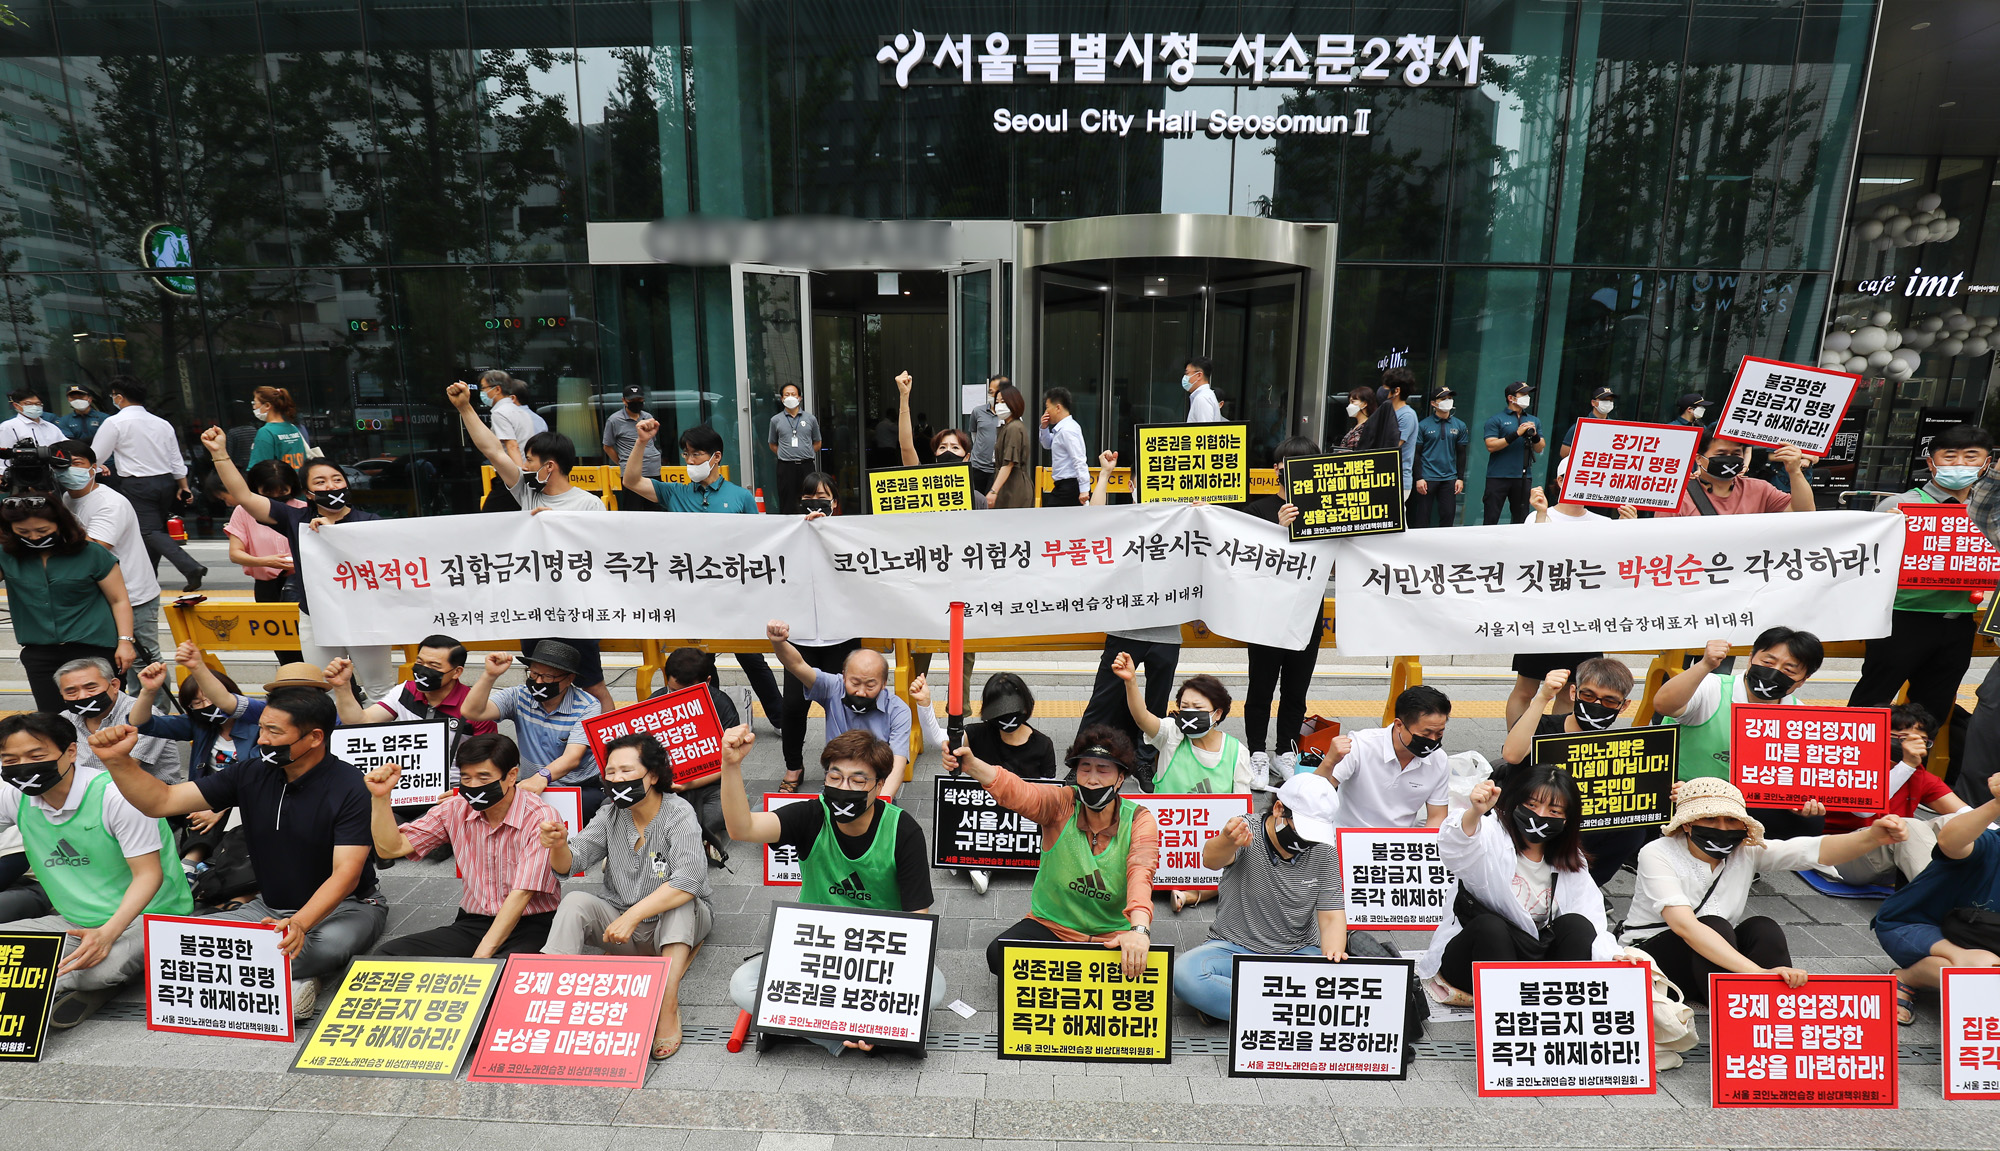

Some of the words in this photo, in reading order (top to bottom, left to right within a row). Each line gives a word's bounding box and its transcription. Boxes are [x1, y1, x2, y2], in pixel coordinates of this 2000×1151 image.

[932, 32, 1198, 85] 서울특별시청
[1224, 34, 1484, 86] 서소문2청사
[994, 109, 1068, 133] Seoul
[1080, 109, 1133, 136] City
[1147, 109, 1196, 133] Hall
[1209, 109, 1348, 133] Seosomun
[1858, 276, 1896, 296] café
[1905, 267, 1964, 297] imt
[1765, 373, 1826, 397] 불공평한
[1741, 389, 1801, 413] 집합금지
[1804, 400, 1835, 419] 명령
[1732, 407, 1762, 426] 즉각
[1764, 413, 1830, 437] 해제하라!
[1146, 436, 1191, 451] 생존권을
[1196, 434, 1240, 450] 위협하는
[1612, 434, 1660, 452] 장기간
[1149, 455, 1205, 472] 집합금지
[1211, 454, 1238, 469] 명령
[1313, 460, 1374, 478] 코인노래방은
[1582, 452, 1644, 471] 집합금지
[1648, 457, 1680, 474] 명령
[876, 477, 918, 493] 생존권을
[922, 474, 964, 489] 위협하는
[1147, 475, 1174, 491] 즉각
[1180, 473, 1240, 489] 해제하라!
[1293, 480, 1313, 494] 감염
[1317, 477, 1346, 492] 시설이
[1350, 473, 1395, 489] 아닙니다!
[1575, 470, 1606, 487] 즉각
[1610, 474, 1678, 493] 해제하라!
[880, 494, 933, 511] 집합금지
[938, 491, 963, 506] 명령
[1321, 495, 1332, 509] 전
[1336, 491, 1370, 507] 국민의
[1303, 504, 1388, 525] 생활공간입니다!
[1908, 516, 1936, 532] 강제
[835, 545, 952, 575] 코인노래방
[962, 540, 1032, 570] 위험성
[1041, 536, 1114, 567] 부풀린
[1123, 530, 1211, 561] 서울시는
[1217, 538, 1315, 581] 사죄하라!
[1923, 536, 1951, 552] 따른
[332, 558, 431, 591] 위법적인
[440, 551, 592, 586] 집합금지명령
[604, 552, 658, 583] 즉각
[669, 554, 786, 585] 취소하라!
[1363, 562, 1505, 596] 서민생존권
[1518, 558, 1606, 592] 짓밟는
[1618, 551, 1733, 588] 박원순은
[1744, 543, 1880, 582] 각성하라!
[1903, 555, 1945, 571] 보상을
[946, 600, 1002, 617] 울지역
[1010, 592, 1160, 614] 코인노래연습장대표자
[1165, 586, 1203, 602] 비대위
[433, 610, 484, 626] 서울지역
[490, 607, 626, 624] 코인노래연습장대표자
[633, 608, 676, 623] 비대위
[1475, 618, 1534, 636] 서울지역
[1541, 613, 1699, 635] 코인노래연습장대표자
[1705, 611, 1754, 629] 비대위
[598, 722, 628, 744] 강제
[630, 699, 704, 734] 영업정지에
[1745, 719, 1780, 738] 강제
[1786, 720, 1876, 742] 영업정지에
[347, 738, 376, 754] 코노
[382, 734, 428, 752] 업주도
[1568, 739, 1644, 762] 코인노래방은
[1765, 742, 1800, 763] 따른
[1806, 744, 1860, 765] 합당한
[1572, 760, 1608, 778] 시설이
[1613, 755, 1668, 776] 아닙니다!
[1742, 765, 1794, 786] 보상을
[1800, 768, 1878, 790] 마련하라!
[1593, 777, 1635, 796] 국민의
[1581, 794, 1656, 816] 공간입니다!
[959, 811, 1038, 832] 서울시를
[1158, 809, 1209, 826] 장기간
[955, 831, 1041, 853] 규탄한다!
[1353, 866, 1422, 884] 집합금지
[1069, 882, 1111, 901] adidas
[1351, 888, 1385, 907] 즉각
[1391, 889, 1447, 907] 해제하
[180, 934, 252, 960] 불공평한
[794, 924, 835, 949] 코노
[844, 928, 907, 955] 업주도
[160, 959, 231, 985] 집합금지
[240, 966, 275, 989] 명령
[800, 953, 894, 985] 국민이다!
[1013, 959, 1082, 982] 생존권을
[348, 972, 415, 992] 생존권을
[416, 973, 482, 995] 위협하는
[513, 972, 554, 995] 강제
[556, 973, 651, 998] 영업정지에
[1262, 976, 1306, 998] 코노
[1316, 977, 1382, 1000] 업주도
[1520, 981, 1609, 1006] 불공평한
[158, 985, 193, 1008] 즉각
[200, 988, 280, 1015] 해제하라!
[767, 980, 836, 1008] 생존권을
[842, 988, 920, 1016] 보장하라!
[1016, 986, 1102, 1010] 집합금지
[1112, 990, 1154, 1011] 명령
[1728, 994, 1769, 1019] 강제
[1776, 994, 1880, 1019] 영업정지에
[162, 1015, 175, 1023] 서울
[336, 997, 422, 1021] 집합금지
[424, 1000, 469, 1023] 명령
[524, 1000, 566, 1024] 따른
[568, 1002, 628, 1026] 합당한
[1272, 1003, 1370, 1027] 국민이다!
[770, 1014, 786, 1025] 서울
[788, 1016, 847, 1031] 코인노래연습장
[849, 1023, 908, 1038] 비상대책위원회
[1012, 1013, 1055, 1035] 즉각
[1063, 1015, 1158, 1038] 해제하라!
[1494, 1012, 1583, 1036] 집합금지
[1592, 1011, 1634, 1035] 명령
[319, 1024, 365, 1047] 즉각
[365, 1025, 461, 1051] 해제하라!
[490, 1028, 550, 1054] 보상을
[554, 1030, 641, 1057] 마련하라!
[1241, 1030, 1313, 1051] 생존권을
[1320, 1032, 1398, 1053] 보장하라!
[1753, 1024, 1794, 1049] 따른
[1801, 1025, 1864, 1050] 합당한
[1492, 1042, 1536, 1066] 즉각
[1544, 1041, 1640, 1065] 해제하라!
[1247, 1061, 1264, 1070] 서울
[1267, 1061, 1327, 1071] 코인노래연습장
[1330, 1062, 1389, 1072] 비상대책위원회
[1726, 1054, 1788, 1079] 보상을
[1795, 1055, 1884, 1080] 마련하라!
[1497, 1077, 1514, 1087] 서울
[1516, 1076, 1576, 1087] 코인노래연습장
[1579, 1076, 1638, 1085] 비상대책위원회
[1732, 1090, 1750, 1100] 서울
[1753, 1091, 1814, 1100] 코인노래연습장
[1818, 1091, 1879, 1100] 비상대책위원회
